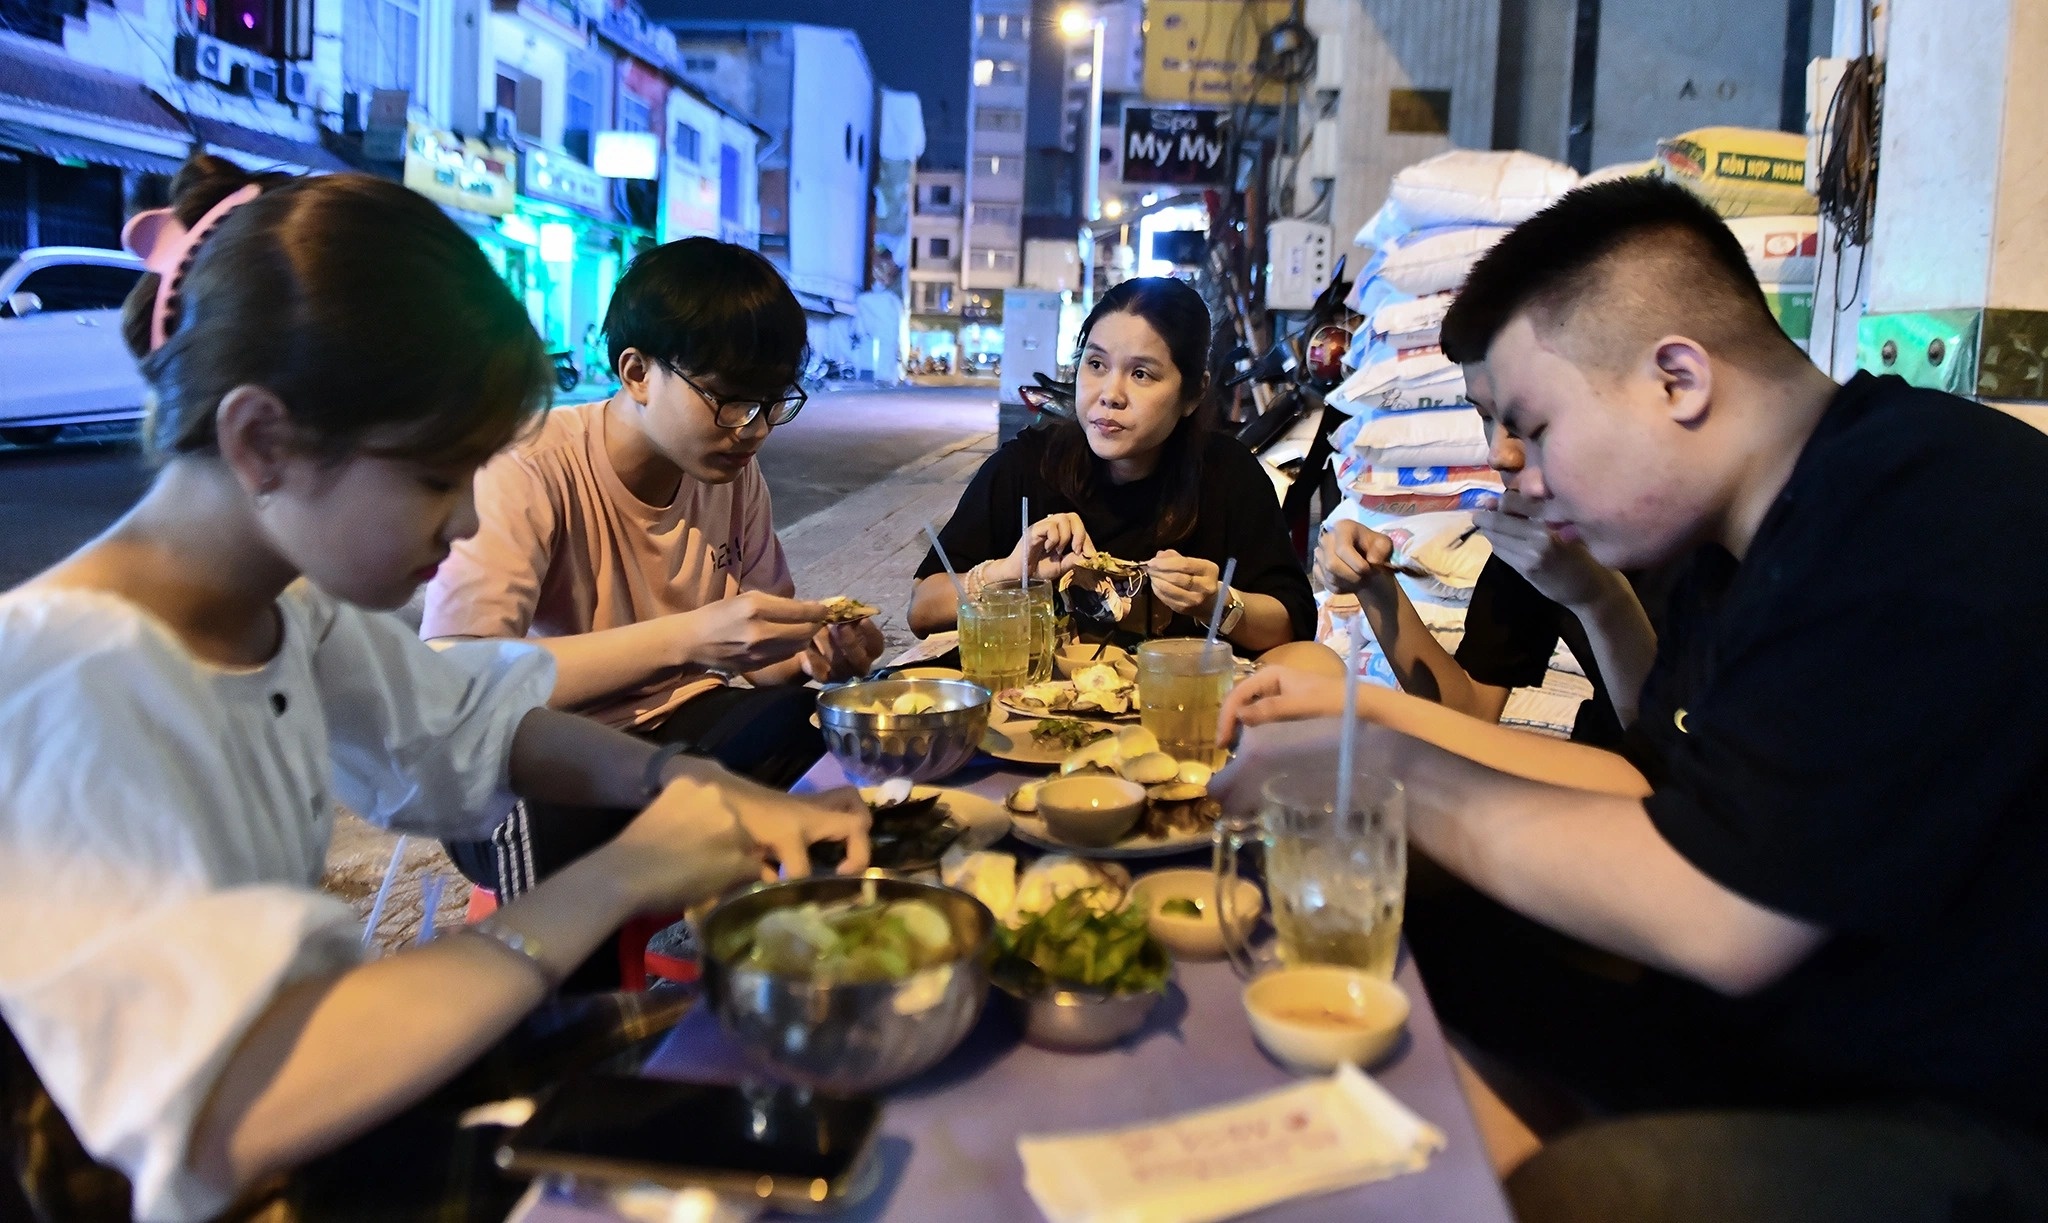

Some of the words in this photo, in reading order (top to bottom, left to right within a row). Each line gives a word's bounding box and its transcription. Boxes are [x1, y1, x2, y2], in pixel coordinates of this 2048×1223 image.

[1151, 111, 1198, 135] Spa
[1129, 132, 1173, 168] My
[1178, 132, 1223, 169] My
